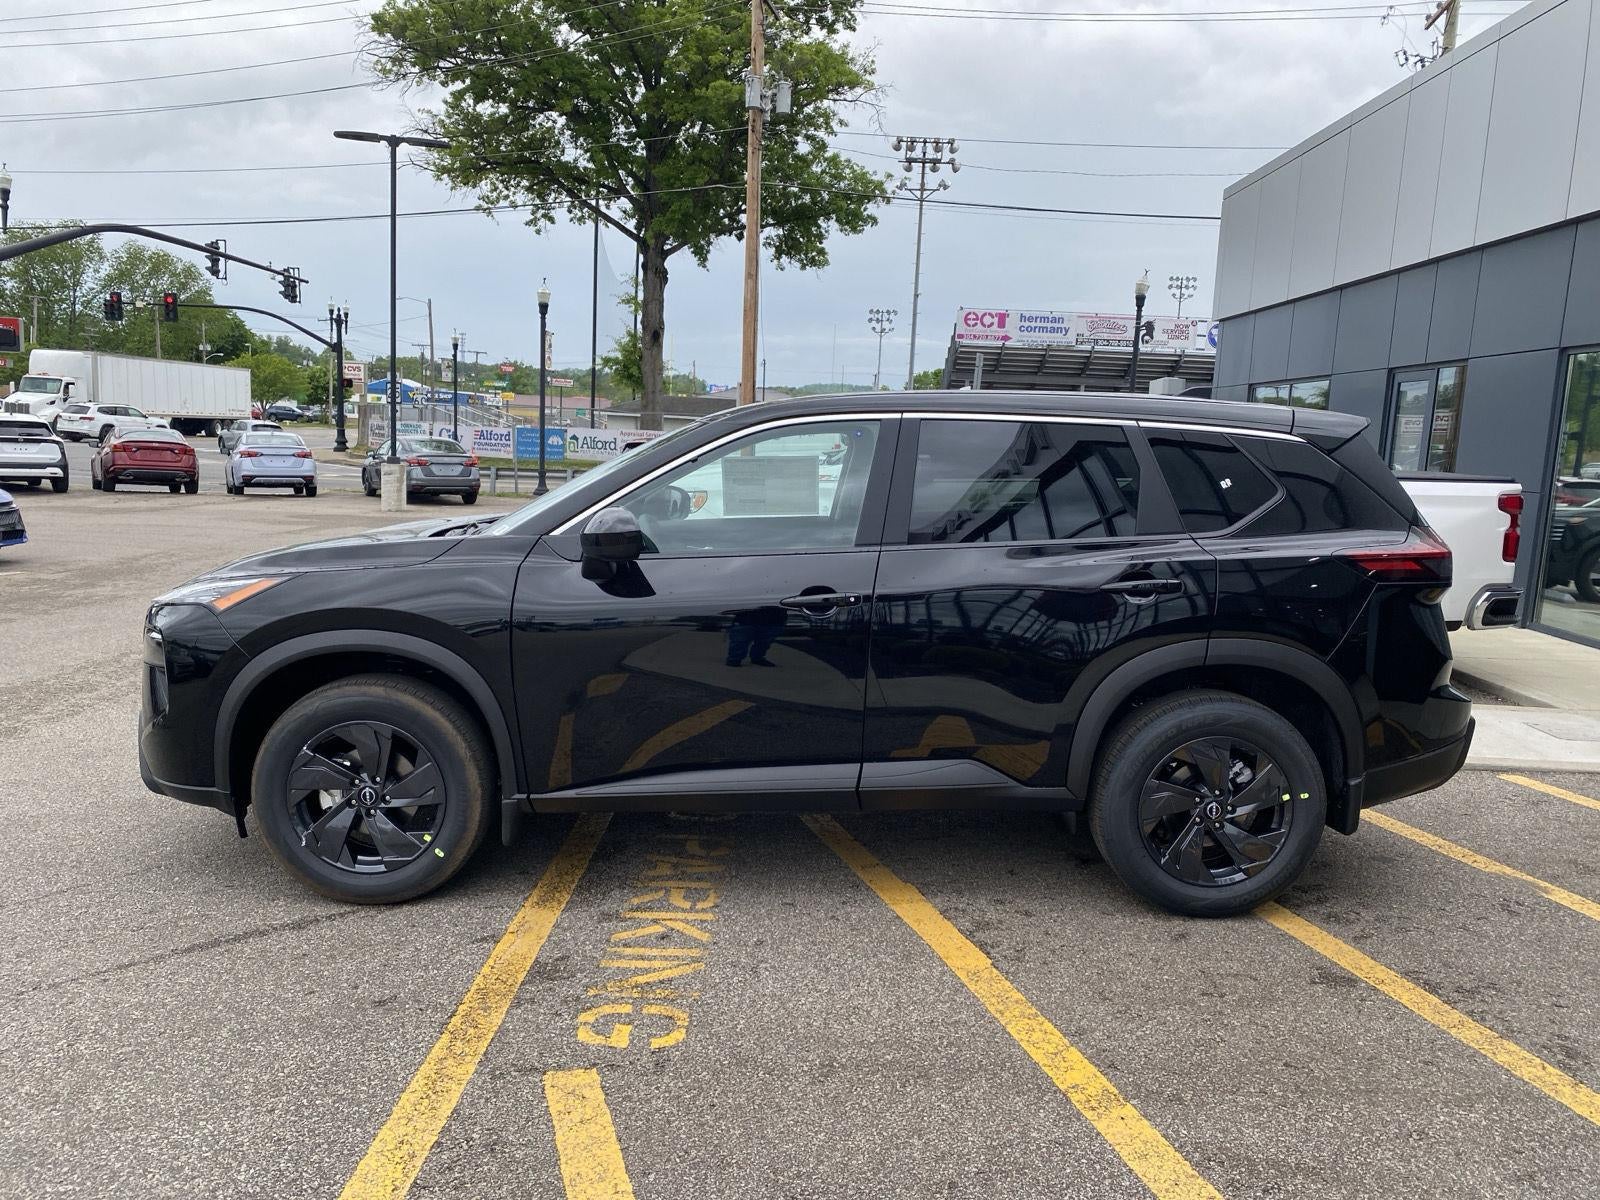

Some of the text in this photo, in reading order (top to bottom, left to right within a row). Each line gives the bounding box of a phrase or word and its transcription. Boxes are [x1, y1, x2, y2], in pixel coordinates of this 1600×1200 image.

[1020, 313, 1064, 324] herman
[1018, 324, 1070, 336] cormany
[479, 430, 511, 442] Alford
[580, 436, 617, 450] Alford
